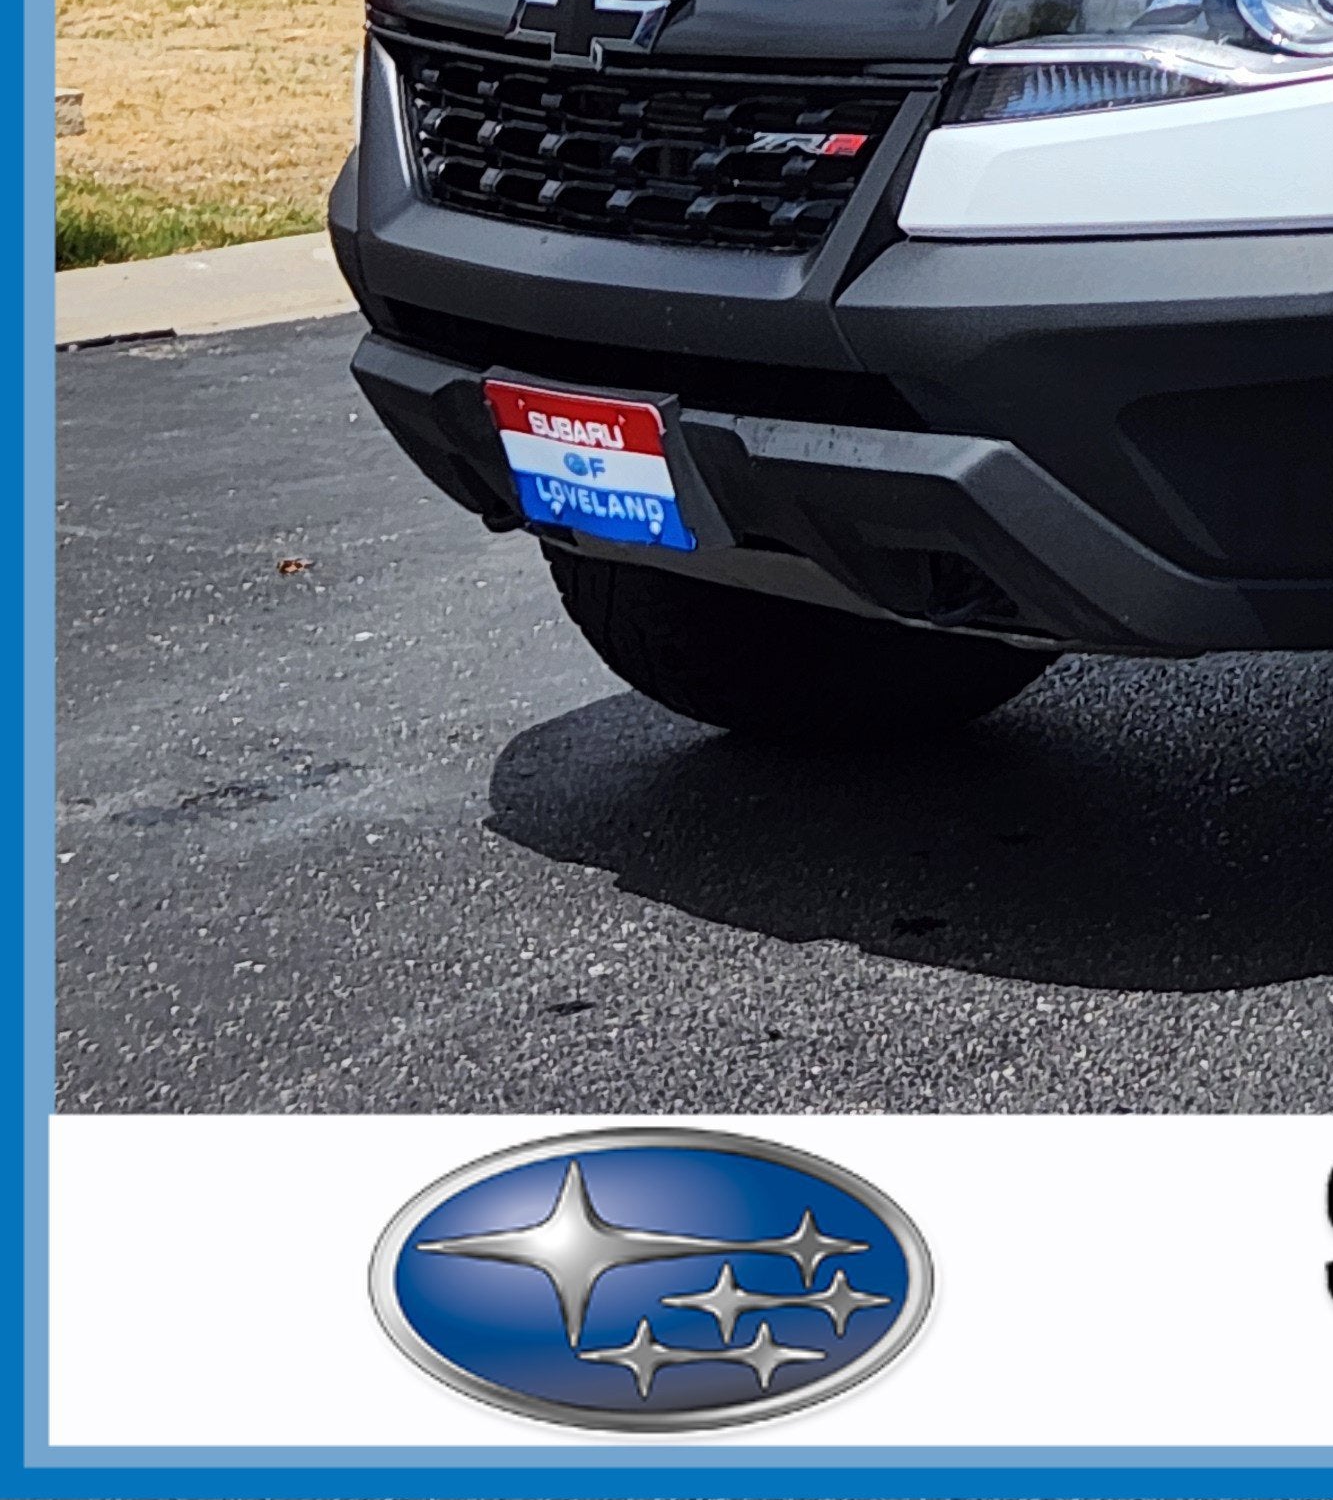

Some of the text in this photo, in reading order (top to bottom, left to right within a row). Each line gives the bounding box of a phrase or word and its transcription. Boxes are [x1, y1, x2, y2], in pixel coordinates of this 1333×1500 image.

[528, 410, 625, 449] SUBARU
[563, 451, 606, 479] OF
[536, 476, 665, 523] LOVELAND
